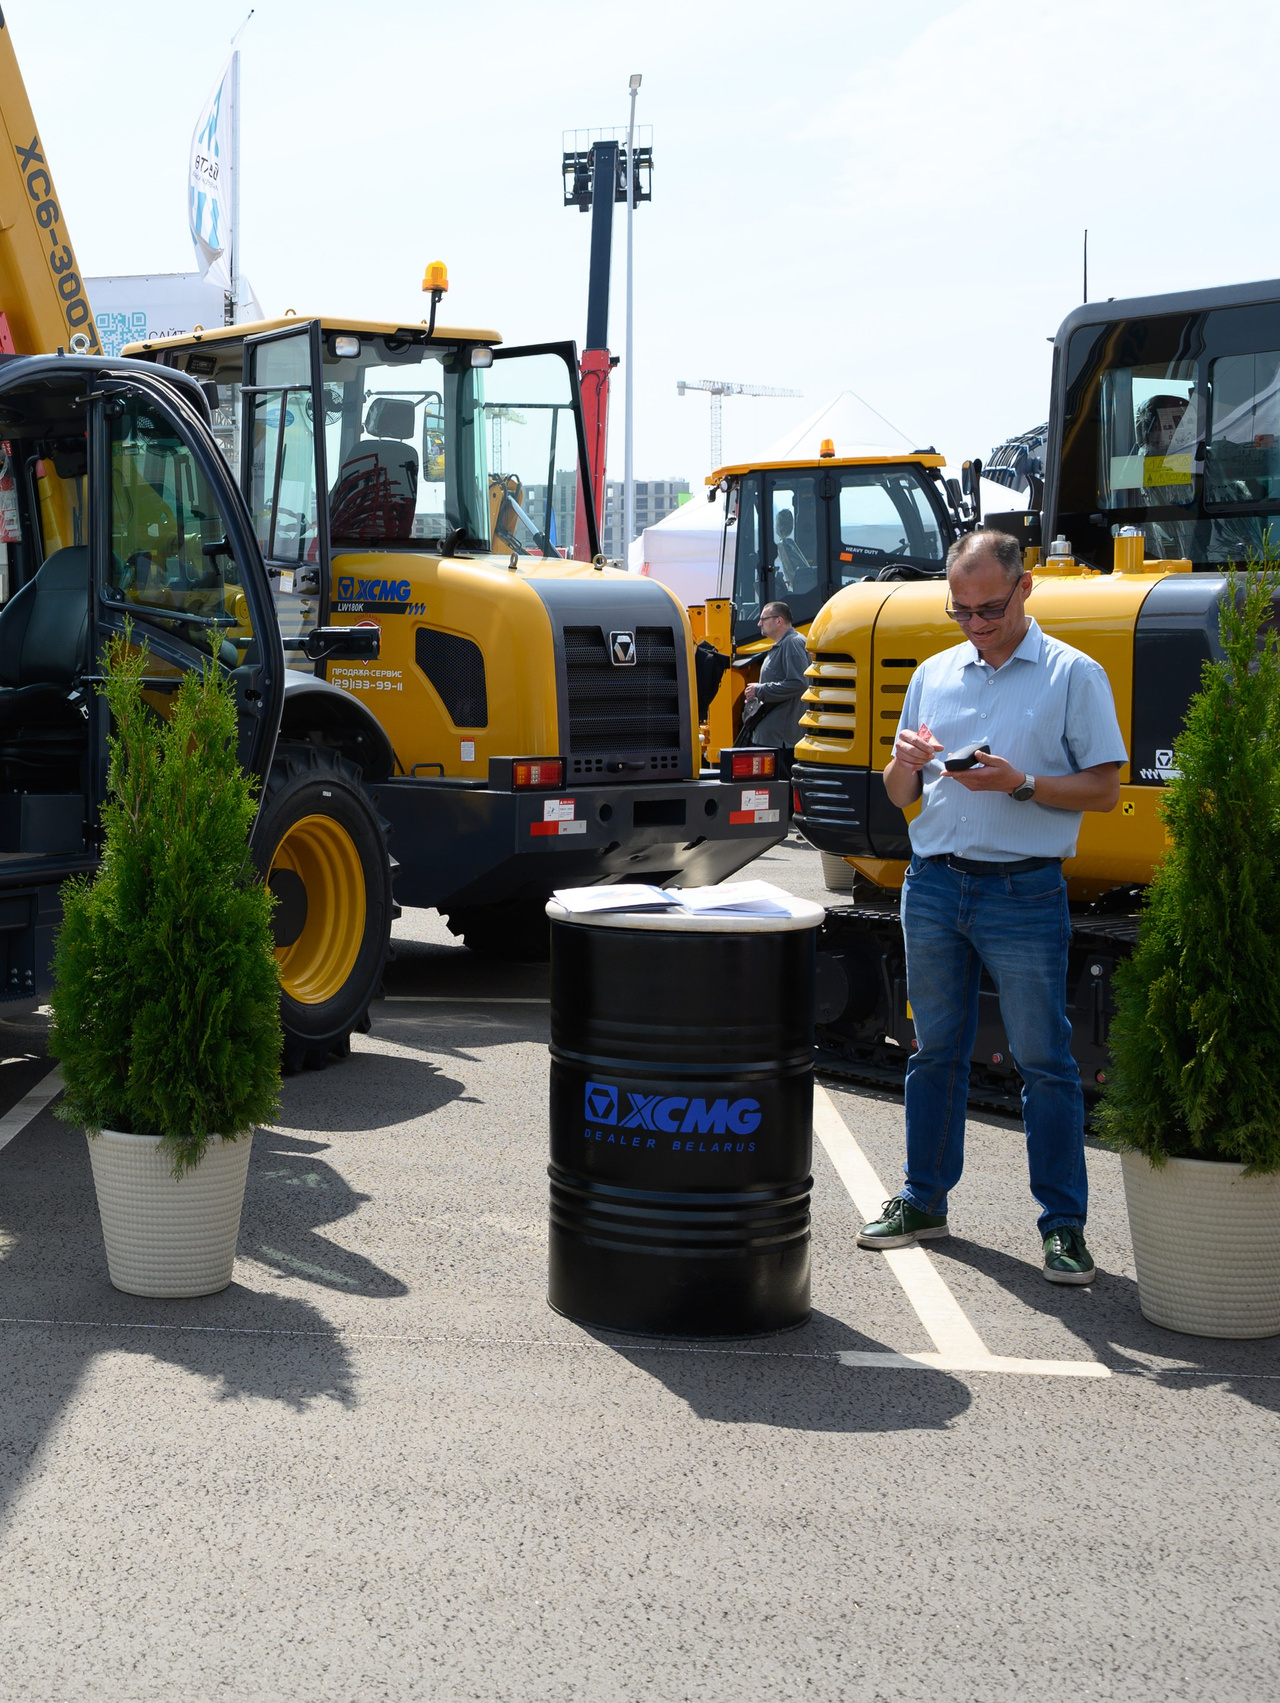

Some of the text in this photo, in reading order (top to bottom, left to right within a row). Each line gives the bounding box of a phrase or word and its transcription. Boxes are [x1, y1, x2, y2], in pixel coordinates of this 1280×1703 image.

[15, 136, 102, 356] XC6-3007
[845, 546, 863, 554] HEAVY
[354, 579, 411, 602] XCMG
[618, 1092, 762, 1135] XCMG
[584, 1128, 756, 1152] DEALER BELARUS
